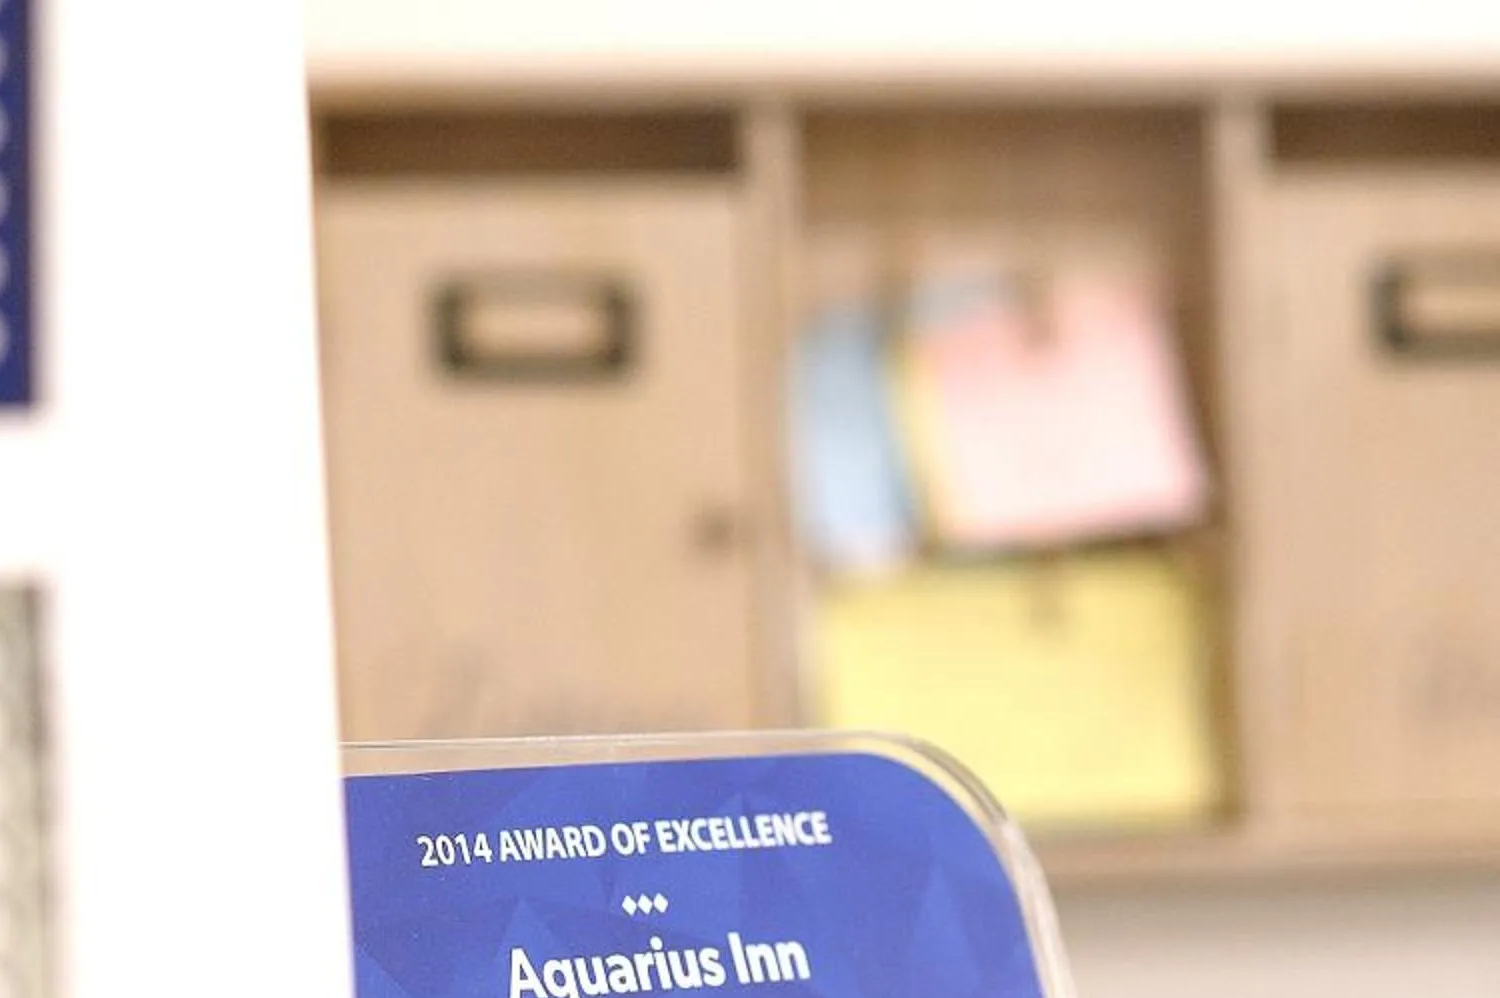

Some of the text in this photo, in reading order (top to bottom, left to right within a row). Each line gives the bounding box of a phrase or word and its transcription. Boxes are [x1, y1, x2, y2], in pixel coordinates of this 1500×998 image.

[418, 811, 832, 866] 2014 AWARD OF EXCELLENCE
[728, 932, 811, 986] Inn
